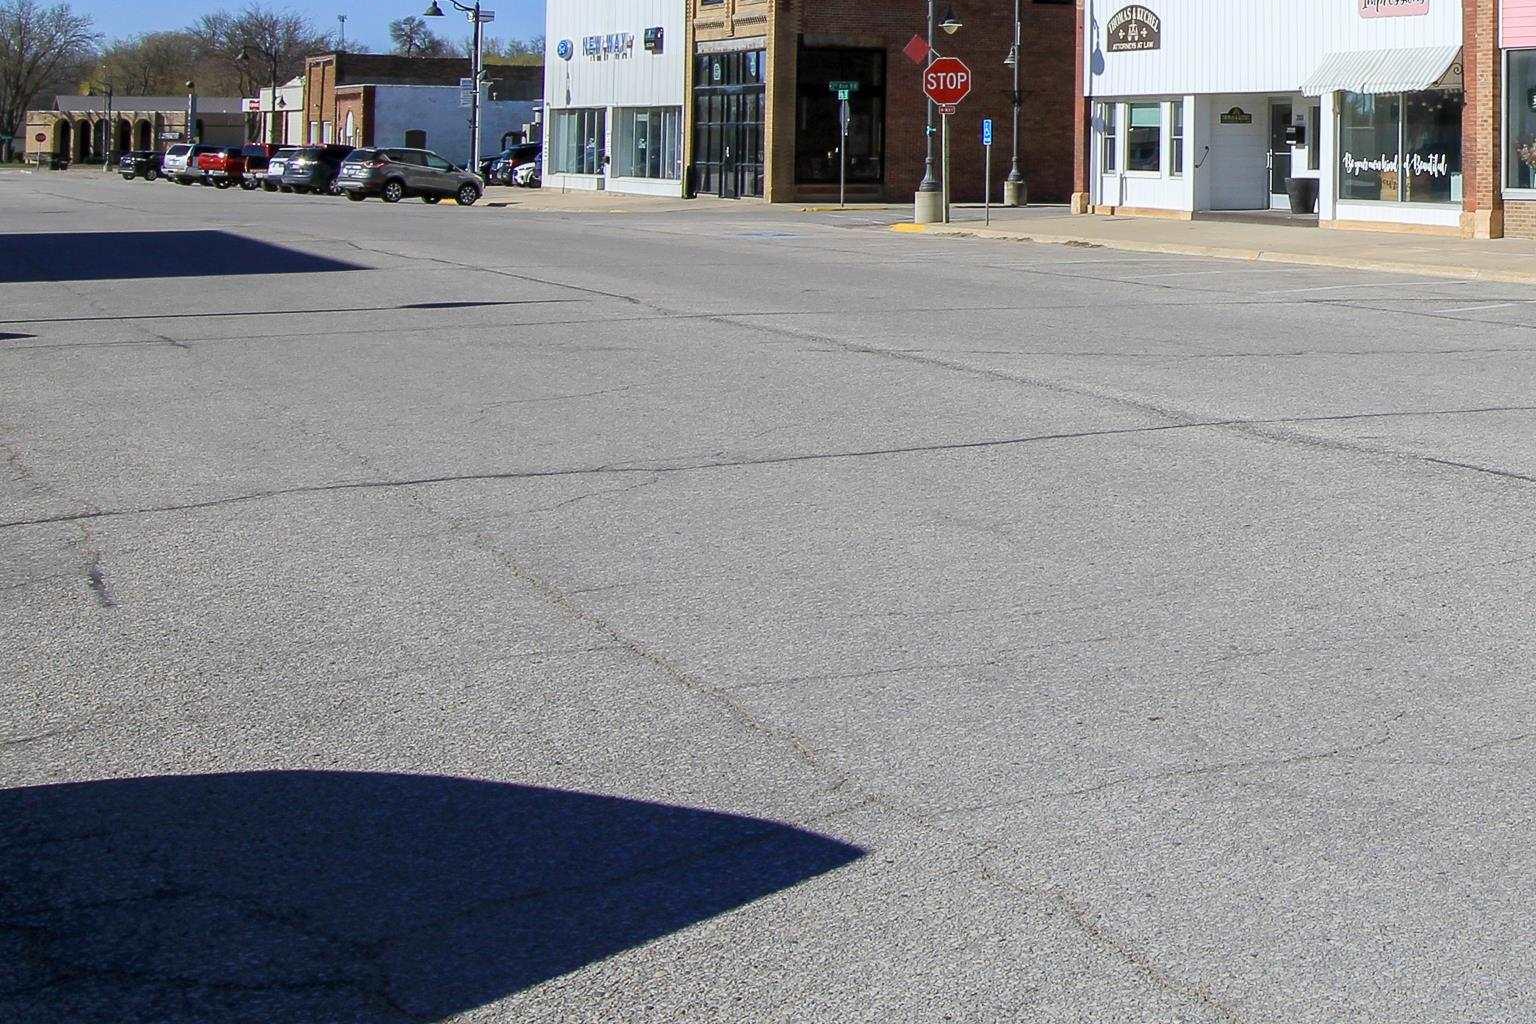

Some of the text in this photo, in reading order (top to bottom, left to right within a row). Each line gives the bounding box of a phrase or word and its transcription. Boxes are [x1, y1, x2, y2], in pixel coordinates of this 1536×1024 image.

[1112, 40, 1155, 51] ATTORNEYS AT LAW
[927, 72, 967, 90] STOP
